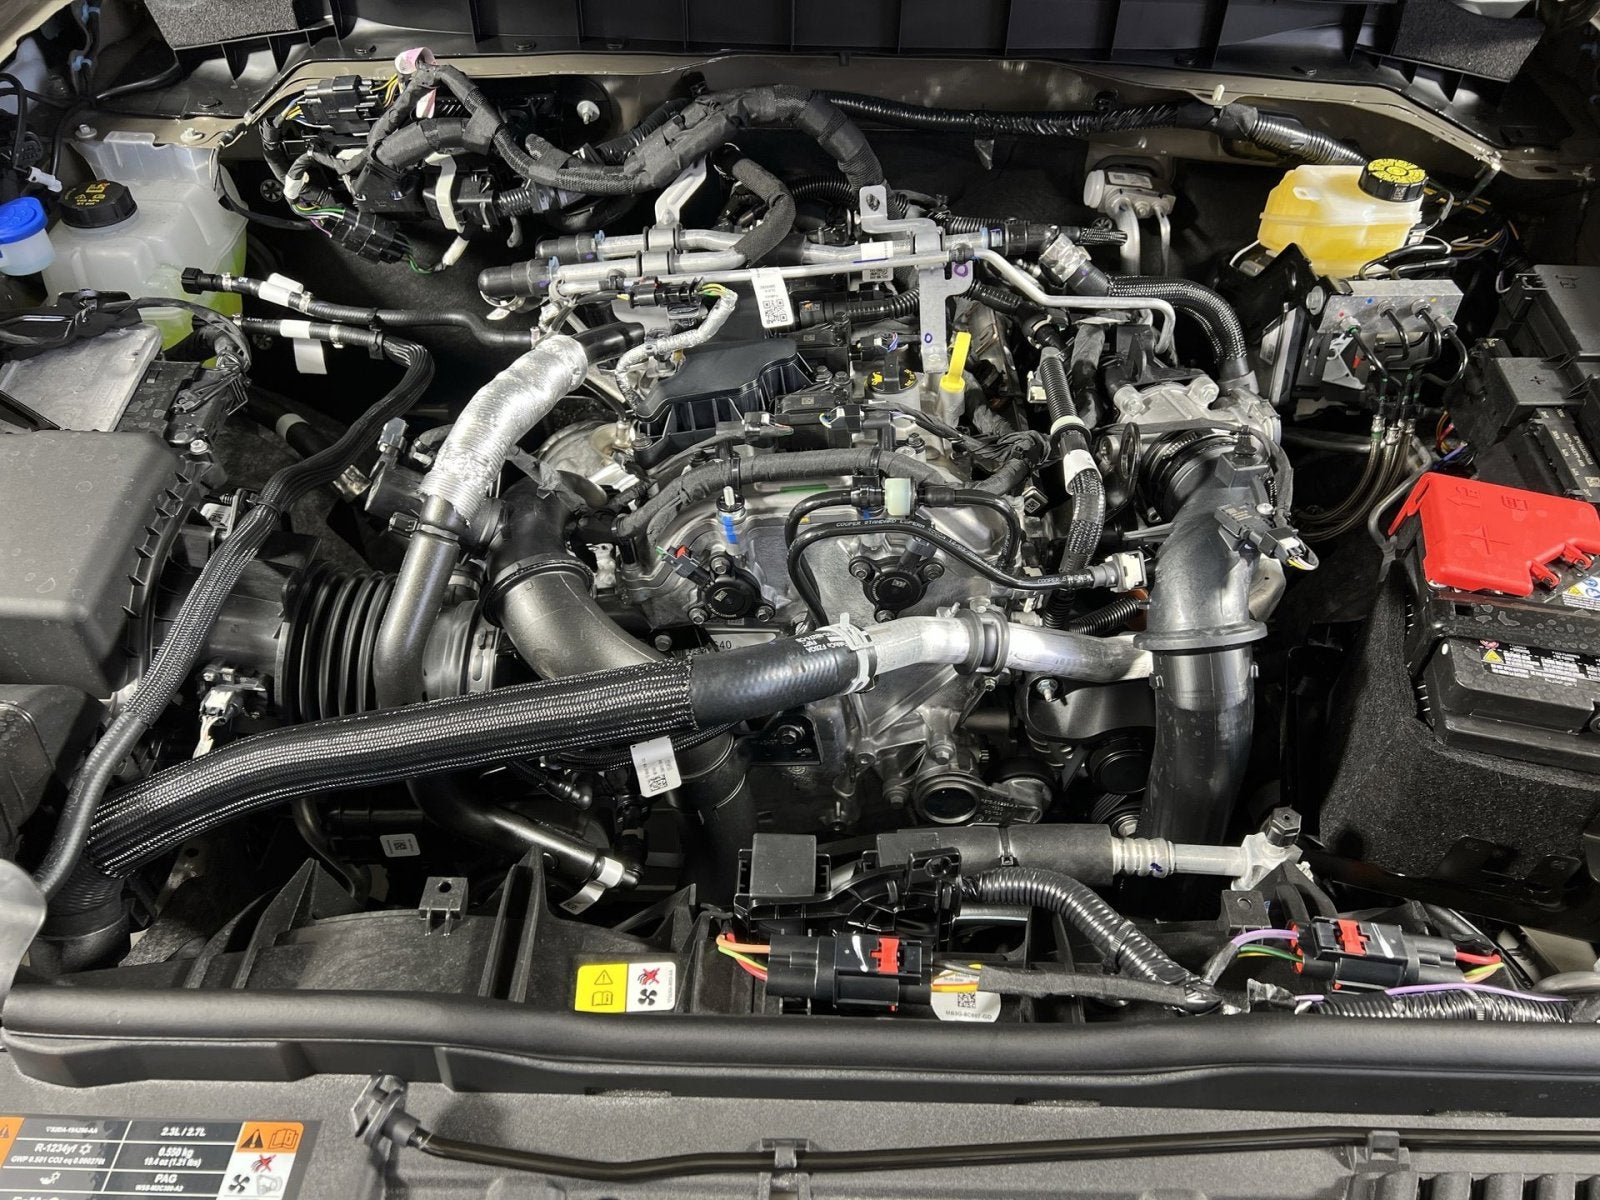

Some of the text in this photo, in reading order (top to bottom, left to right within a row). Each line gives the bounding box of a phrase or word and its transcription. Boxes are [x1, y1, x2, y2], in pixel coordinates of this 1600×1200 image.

[836, 520, 861, 528] COOPER
[160, 1126, 181, 1136] 2.3L
[186, 1127, 206, 1137] 2.7L
[34, 1143, 79, 1155] R-1234yf
[181, 1147, 194, 1159] kg
[11, 1155, 29, 1163] GWP
[48, 1156, 62, 1164] CO2
[63, 1158, 72, 1166] eq
[154, 1174, 178, 1184] PAG
